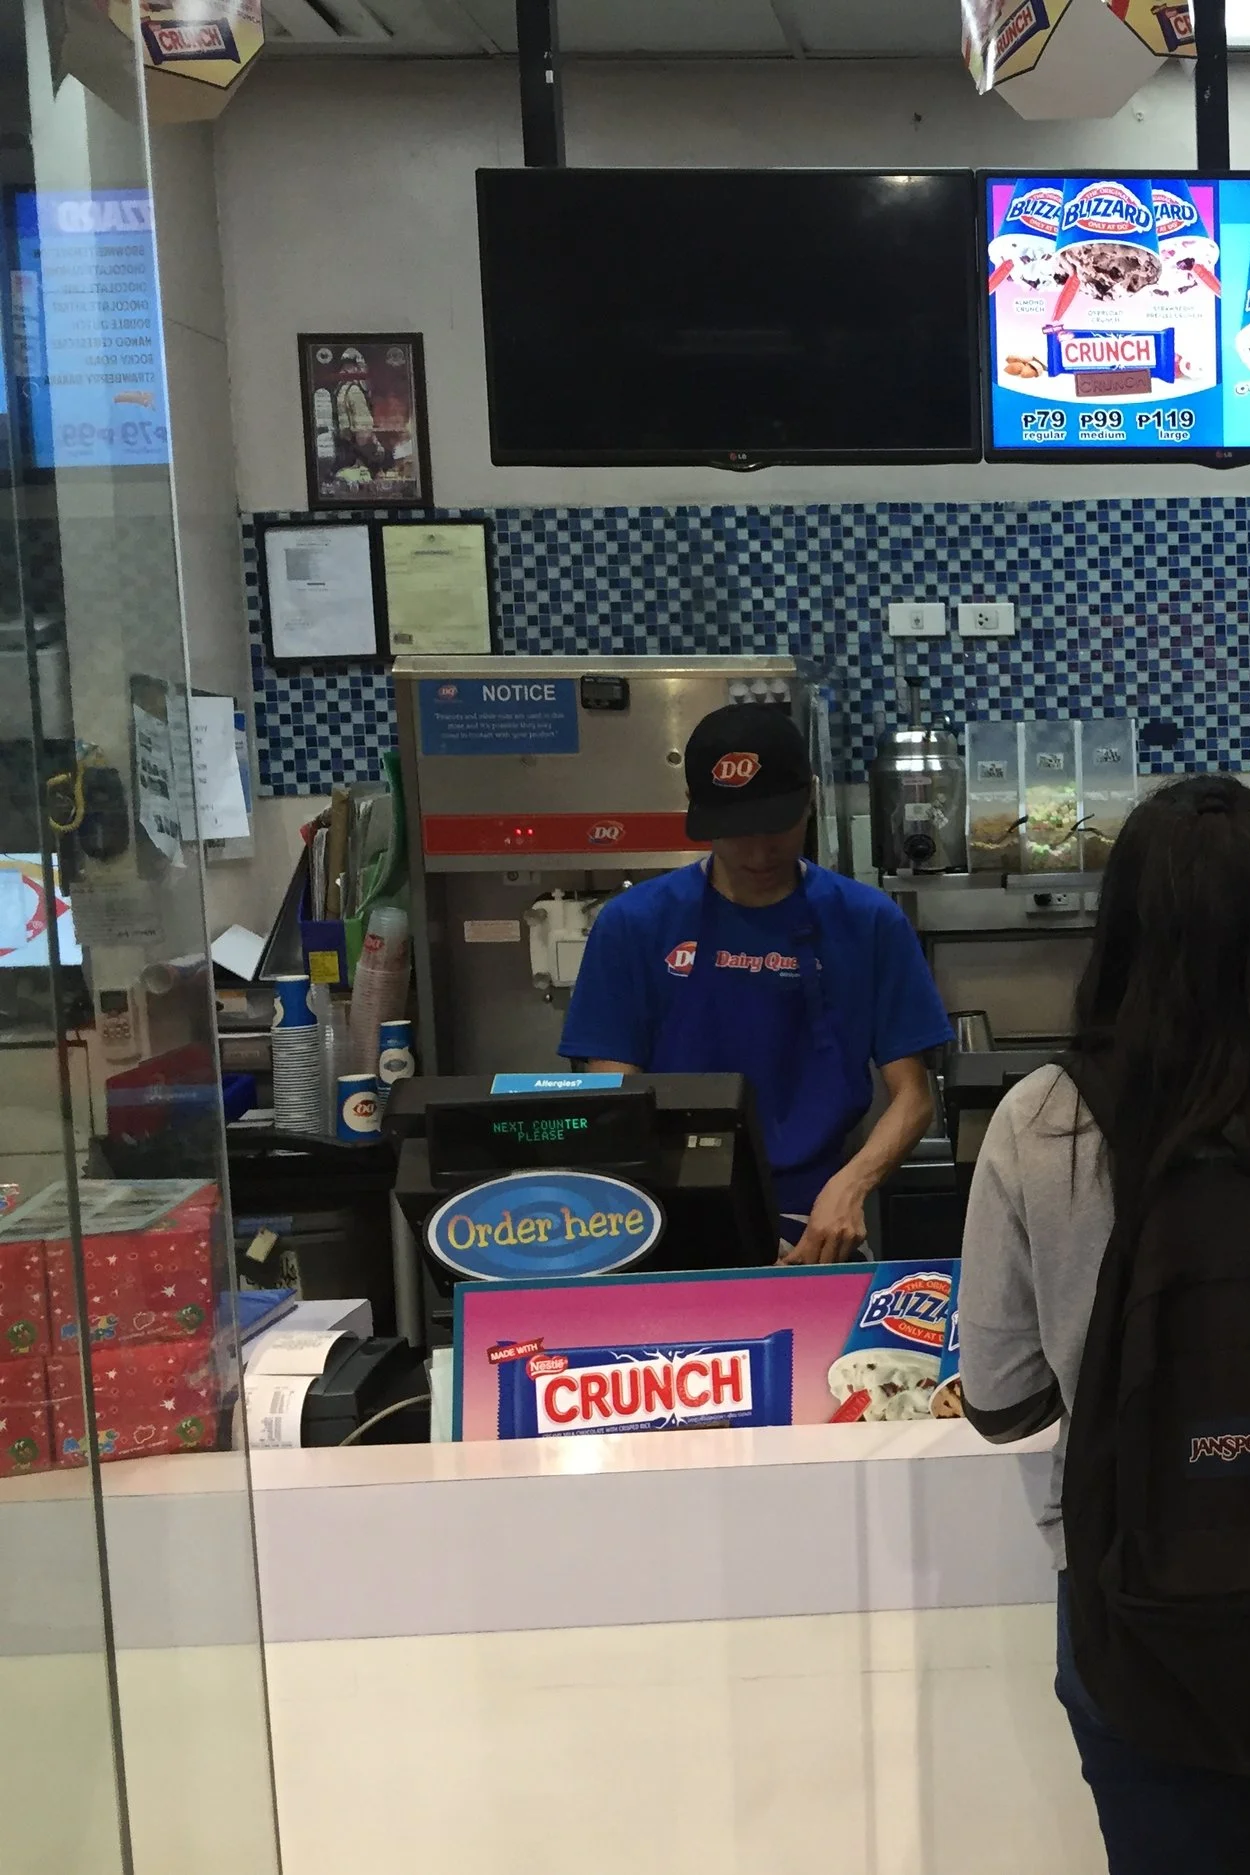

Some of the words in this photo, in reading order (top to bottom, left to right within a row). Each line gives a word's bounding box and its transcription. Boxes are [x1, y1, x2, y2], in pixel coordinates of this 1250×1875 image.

[158, 26, 222, 51] CRUCH
[1064, 198, 1150, 227] BLIZZARD
[1065, 340, 1150, 363] CRUNCH
[1023, 430, 1067, 442] regular
[1080, 429, 1126, 440] medium
[1159, 429, 1190, 442] large
[483, 684, 556, 701] NOTICE
[720, 759, 753, 779] DQ
[594, 826, 619, 840] DQ
[715, 950, 763, 972] Dairy
[534, 1079, 582, 1088] Allergies?
[494, 1121, 524, 1132] NEXT
[533, 1118, 588, 1131] COUNTER
[518, 1130, 564, 1141] PLEASE
[448, 1208, 551, 1250] Order
[561, 1207, 644, 1240] here
[906, 1282, 925, 1291] THE
[898, 1322, 922, 1335] ONLY
[490, 1349, 515, 1360] MADE
[516, 1343, 538, 1355] WITH
[543, 1355, 743, 1424] CRUNCH
